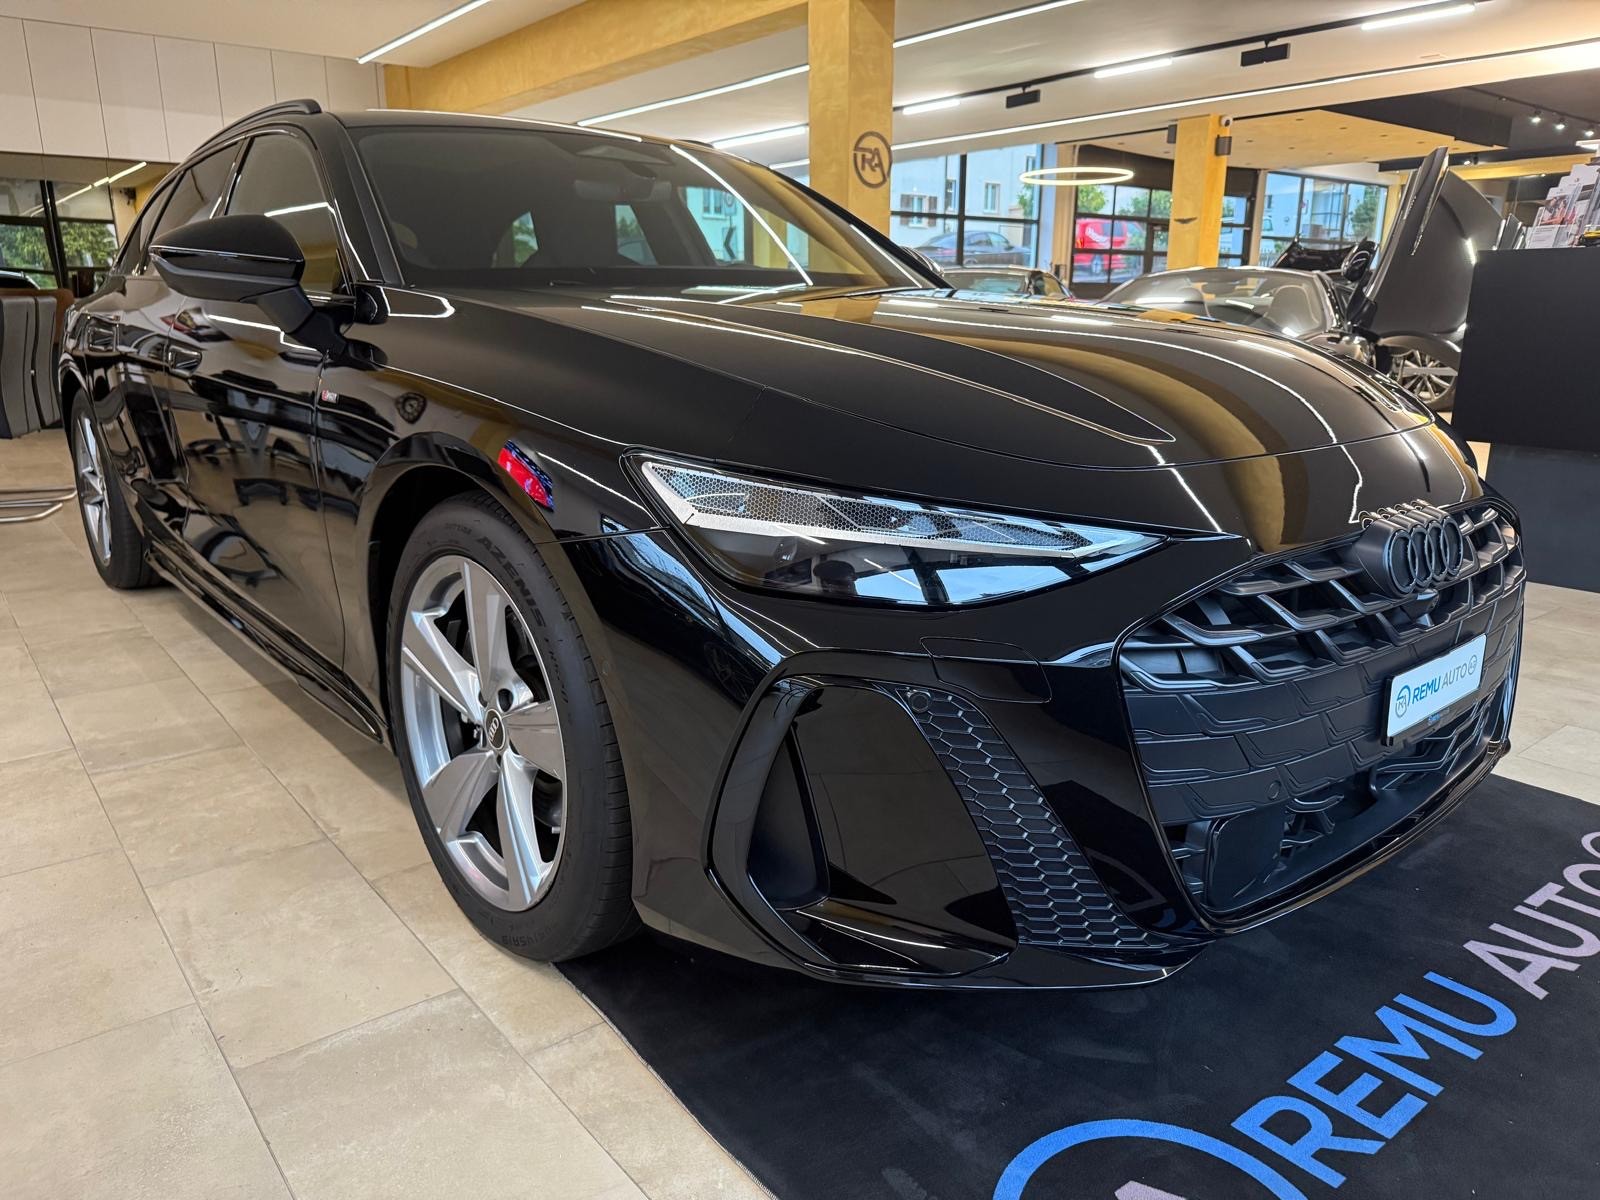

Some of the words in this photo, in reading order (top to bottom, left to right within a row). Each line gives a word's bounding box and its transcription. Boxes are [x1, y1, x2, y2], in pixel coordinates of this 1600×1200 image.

[476, 536, 546, 627] AZENIS
[1412, 676, 1441, 704] REMU
[1442, 663, 1467, 688] AUTO
[1231, 971, 1517, 1188] REMU
